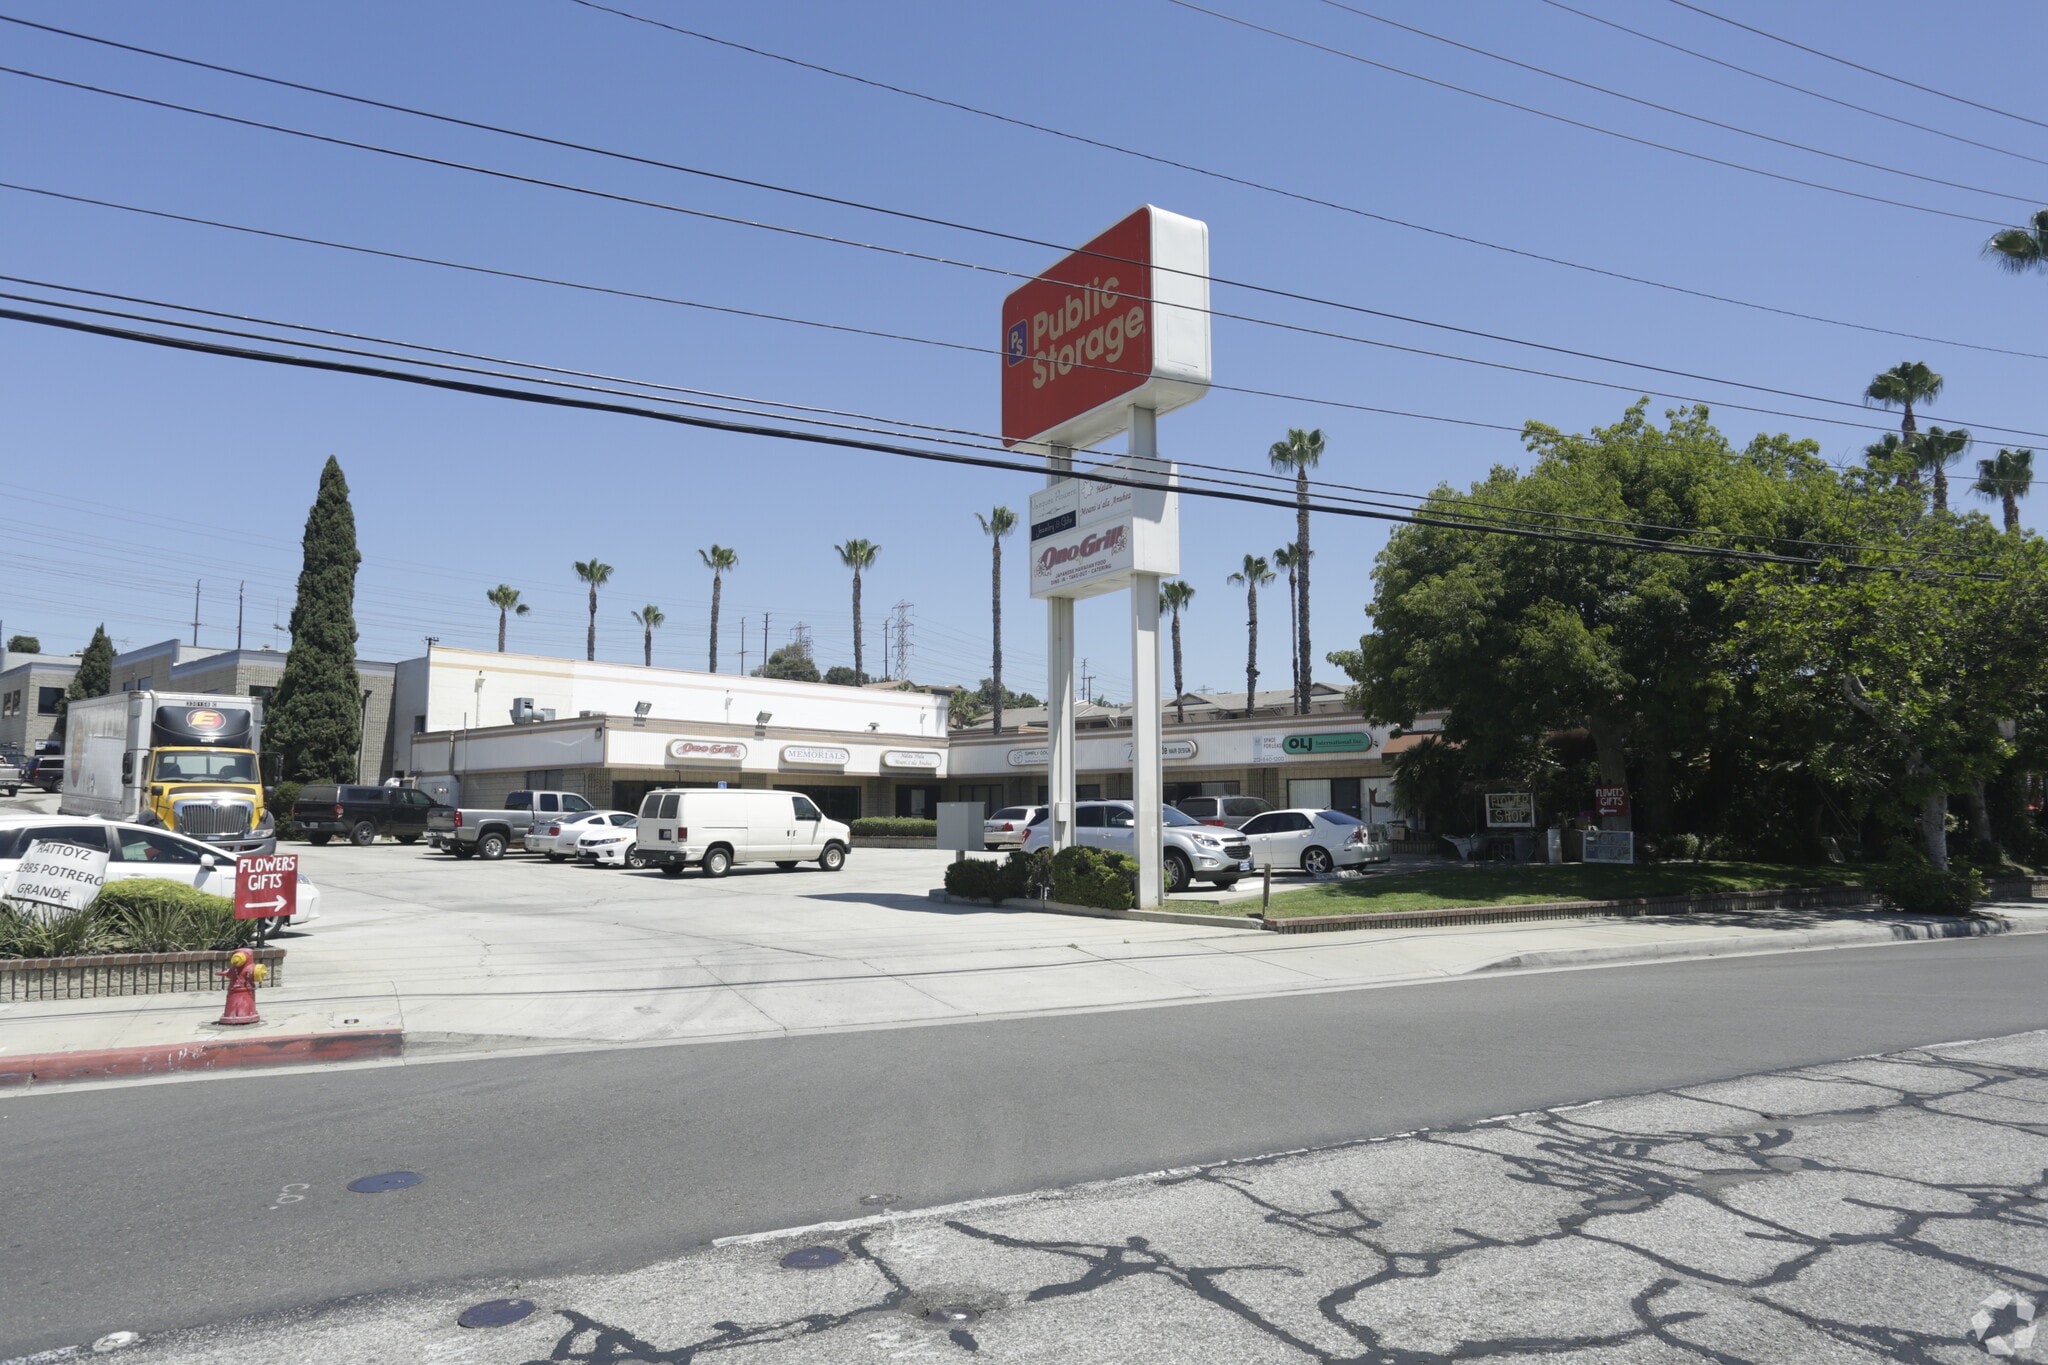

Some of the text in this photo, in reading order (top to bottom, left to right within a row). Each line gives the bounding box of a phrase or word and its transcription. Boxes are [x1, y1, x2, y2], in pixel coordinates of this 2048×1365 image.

[1033, 276, 1119, 350] Public
[1032, 306, 1144, 389] Storage
[1040, 525, 1125, 570] Ono Grill
[1091, 563, 1112, 573] CATERING
[1095, 558, 1107, 567] FOOD
[683, 743, 738, 754] Ono Grill
[1289, 737, 1312, 751] OLJ
[787, 750, 846, 760] MEMORIALS
[1595, 787, 1624, 798] FLOWERS
[1491, 795, 1529, 808] FLOWER
[1600, 797, 1624, 806] GIFTS
[1495, 809, 1526, 823] SHOP
[37, 844, 92, 861] RATTOYZ
[239, 856, 296, 874] FLOWERS
[16, 862, 105, 887] 1985 POTRERO
[248, 873, 283, 891] GIFTS
[17, 883, 71, 902] GRANDE
